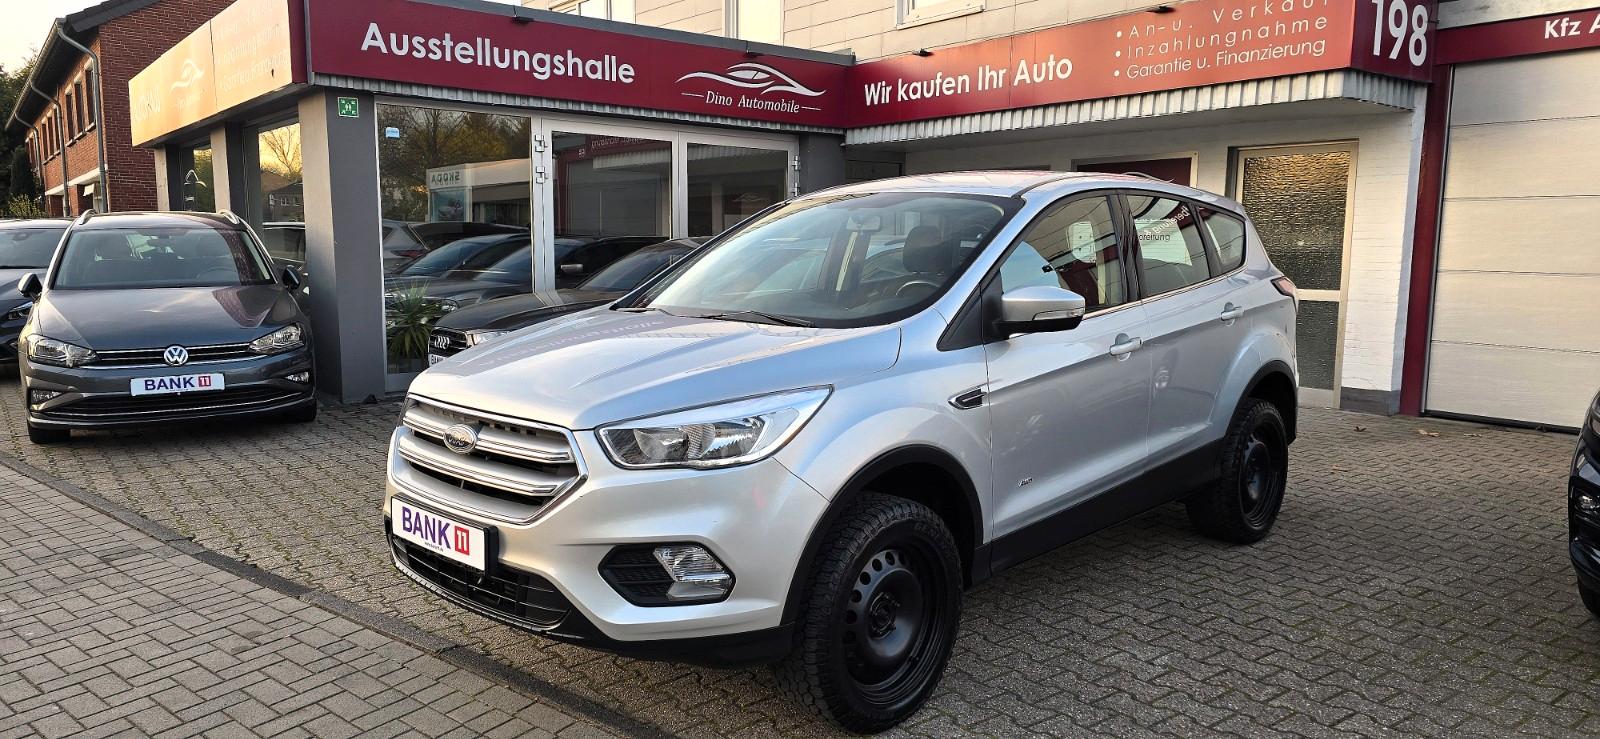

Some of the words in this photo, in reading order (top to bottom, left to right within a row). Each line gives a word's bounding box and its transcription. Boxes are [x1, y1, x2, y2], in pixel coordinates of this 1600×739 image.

[1212, 0, 1328, 23] Verkau
[1545, 17, 1582, 39] Kfz
[361, 22, 635, 83] Ausstellungshalle
[1128, 16, 1328, 59] Inzahlungnahme
[1372, 0, 1428, 66] 198
[1127, 59, 1192, 79] Garantie
[1196, 58, 1211, 69] u.
[1216, 39, 1326, 67] Finanzierung
[864, 82, 892, 106] Wir
[898, 71, 970, 102] kaufen
[978, 64, 1007, 91] Ihr
[1013, 54, 1073, 87] Auto
[706, 90, 733, 106] Dino
[738, 94, 800, 113] Automobile
[144, 376, 195, 391] BANK
[199, 377, 210, 387] 11
[402, 506, 451, 550] BANK
[456, 528, 468, 552] 11
